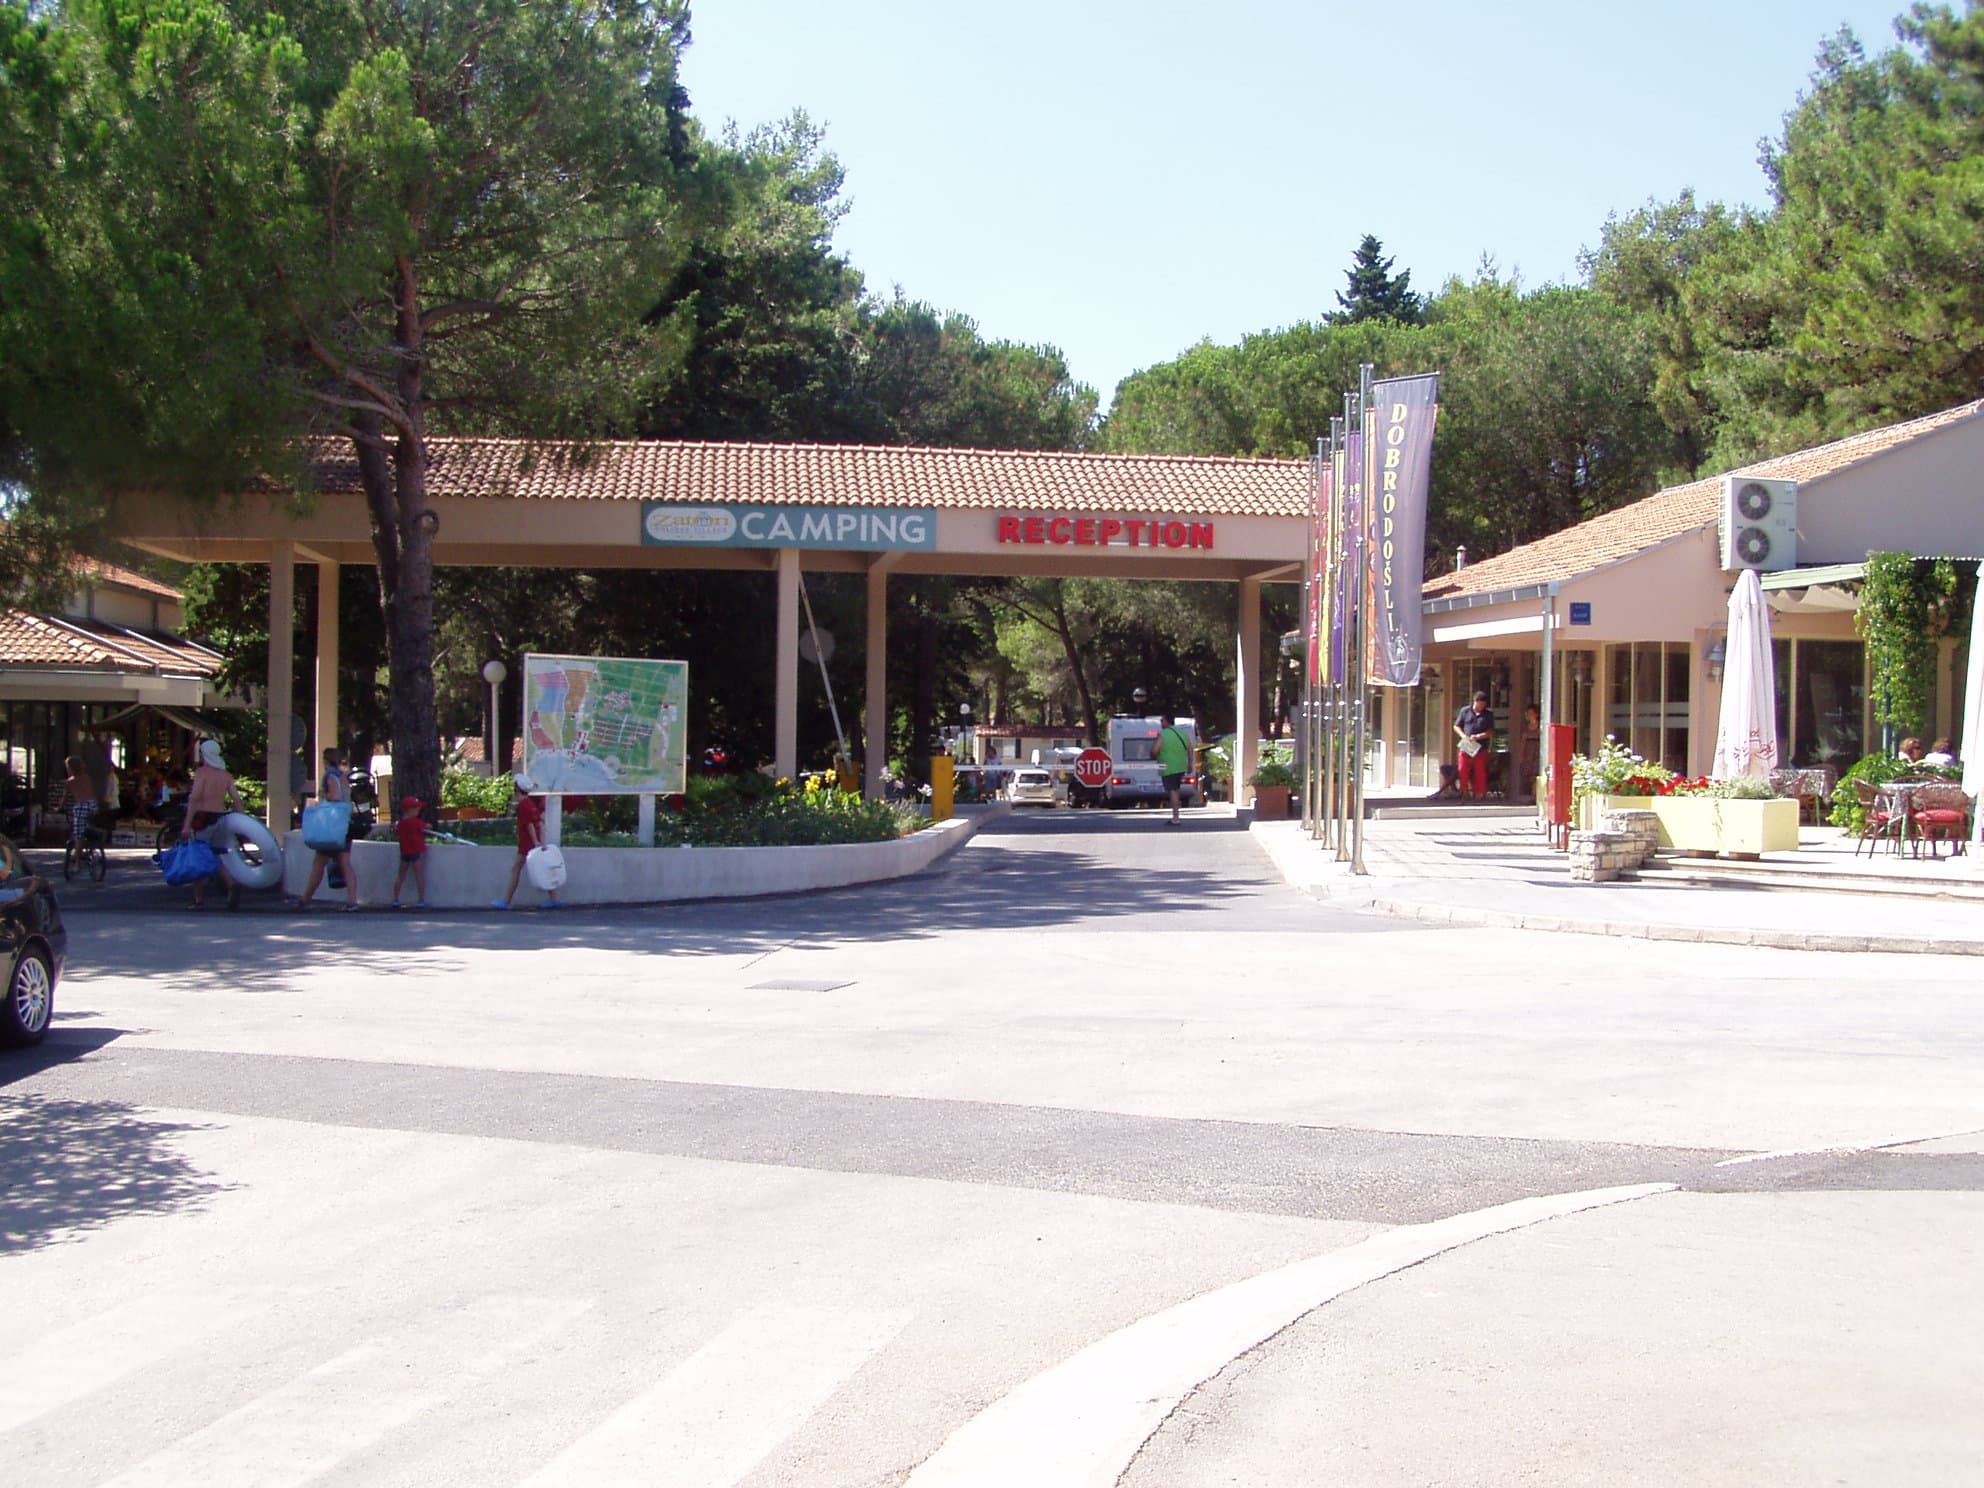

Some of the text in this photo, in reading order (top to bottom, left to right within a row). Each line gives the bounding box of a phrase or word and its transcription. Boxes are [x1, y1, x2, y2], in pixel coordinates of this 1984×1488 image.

[741, 512, 926, 543] CAMPING
[999, 516, 1214, 549] RECEPTION
[1383, 403, 1407, 632] DOBRODOŠLI
[1077, 760, 1111, 776] STOP
